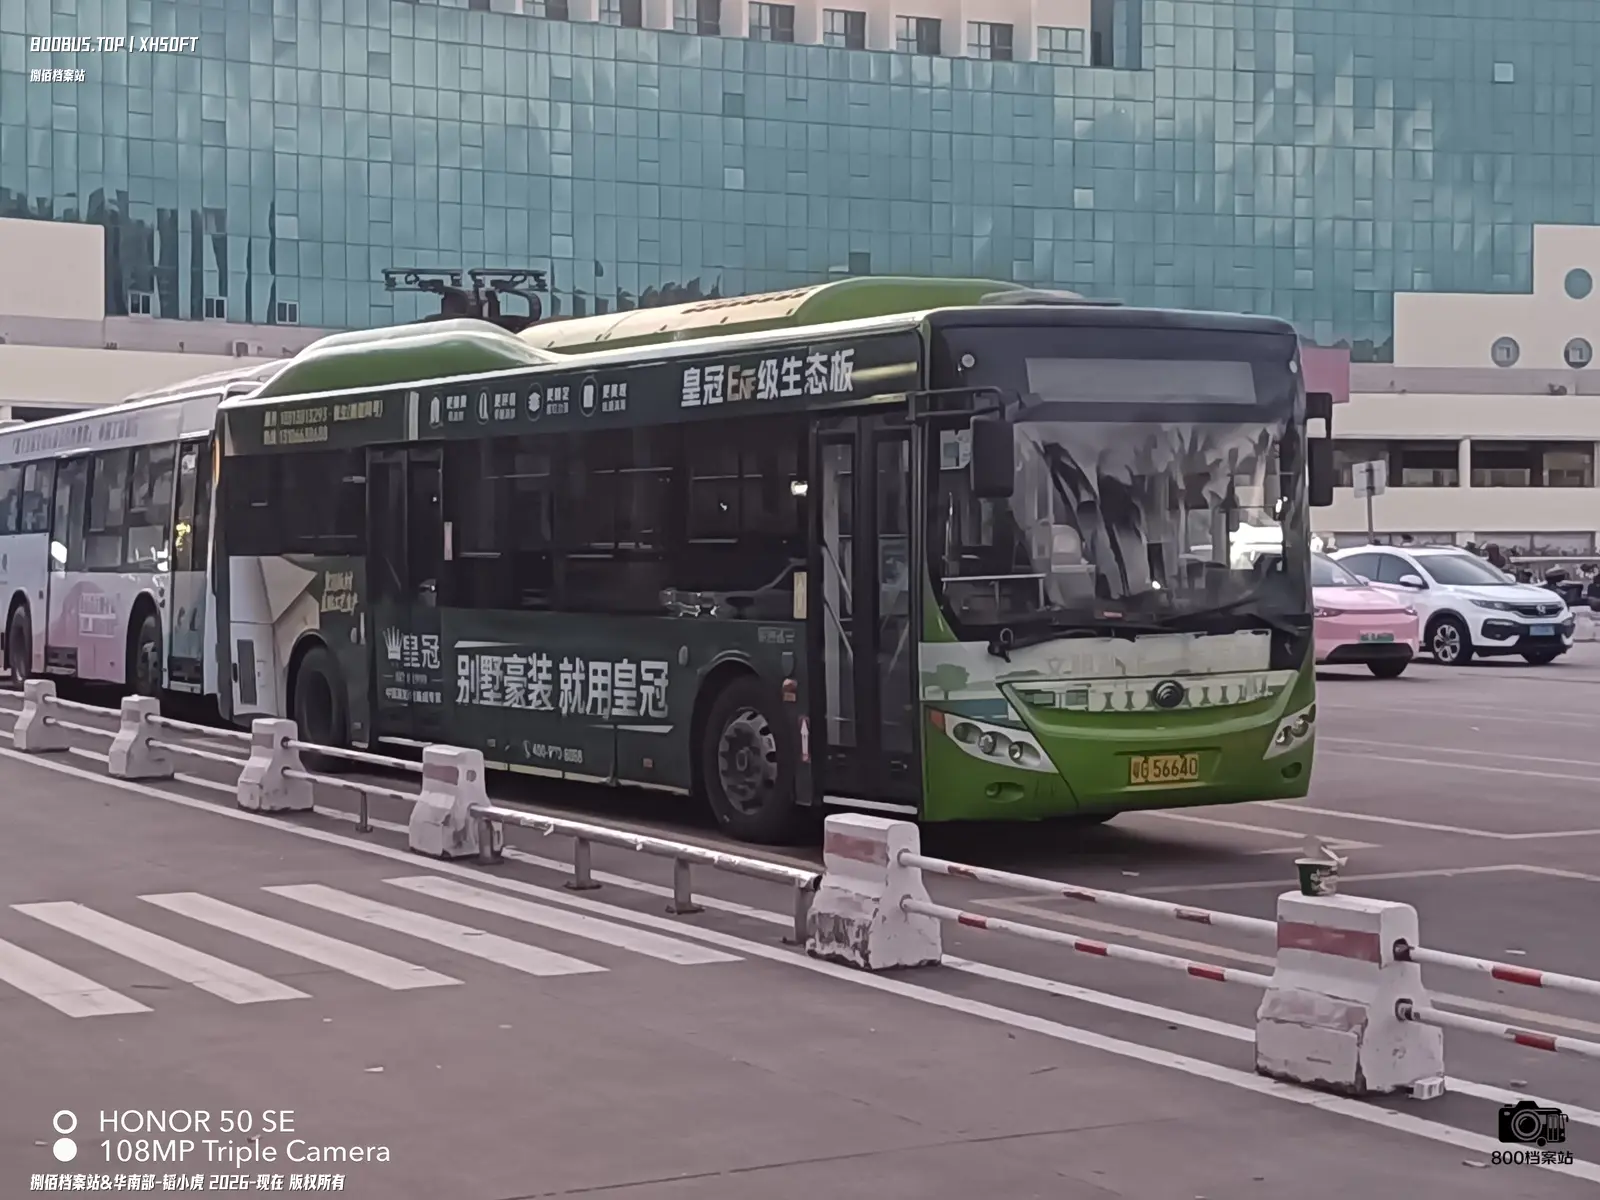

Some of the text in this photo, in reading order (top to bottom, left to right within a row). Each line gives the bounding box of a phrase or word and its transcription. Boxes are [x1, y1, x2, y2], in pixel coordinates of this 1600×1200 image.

[403, 633, 441, 669] 皇冠
[455, 652, 669, 720] 别墅豪装 就用皇冠
